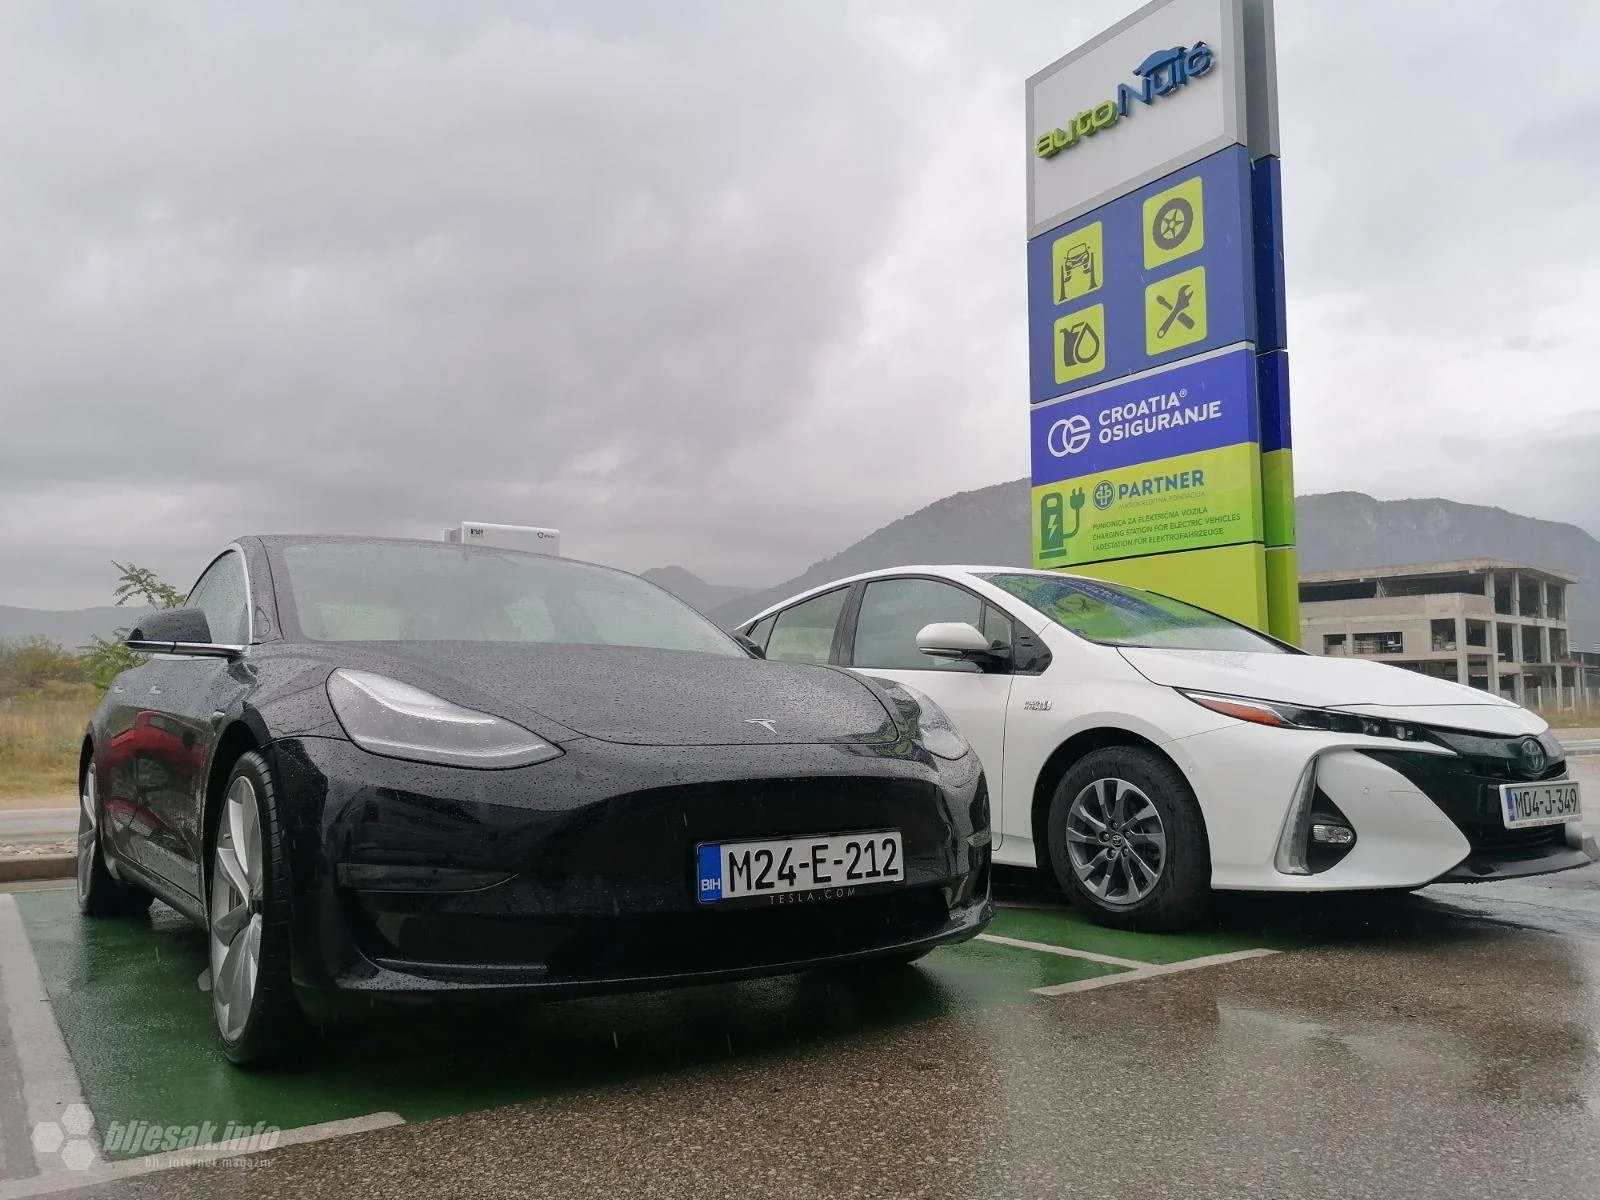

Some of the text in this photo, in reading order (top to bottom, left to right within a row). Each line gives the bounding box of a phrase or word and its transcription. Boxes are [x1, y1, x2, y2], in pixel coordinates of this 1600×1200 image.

[1099, 401, 1222, 444] OSIGURANJE
[1118, 469, 1205, 500] PARTNER
[1092, 513, 1241, 541] CHARGING STATION FOR ELECTRIC VEHICLES
[1127, 517, 1137, 525] ZA
[1181, 506, 1208, 517] VOZILA
[1092, 539, 1133, 552] LADESTATION
[1148, 527, 1224, 544] ELEKTROFAHRZEUGE
[1514, 788, 1577, 817] M04-J-349
[728, 838, 899, 892] M24-E-212
[701, 878, 721, 891] BIH
[770, 887, 856, 904] TESLA.COM
